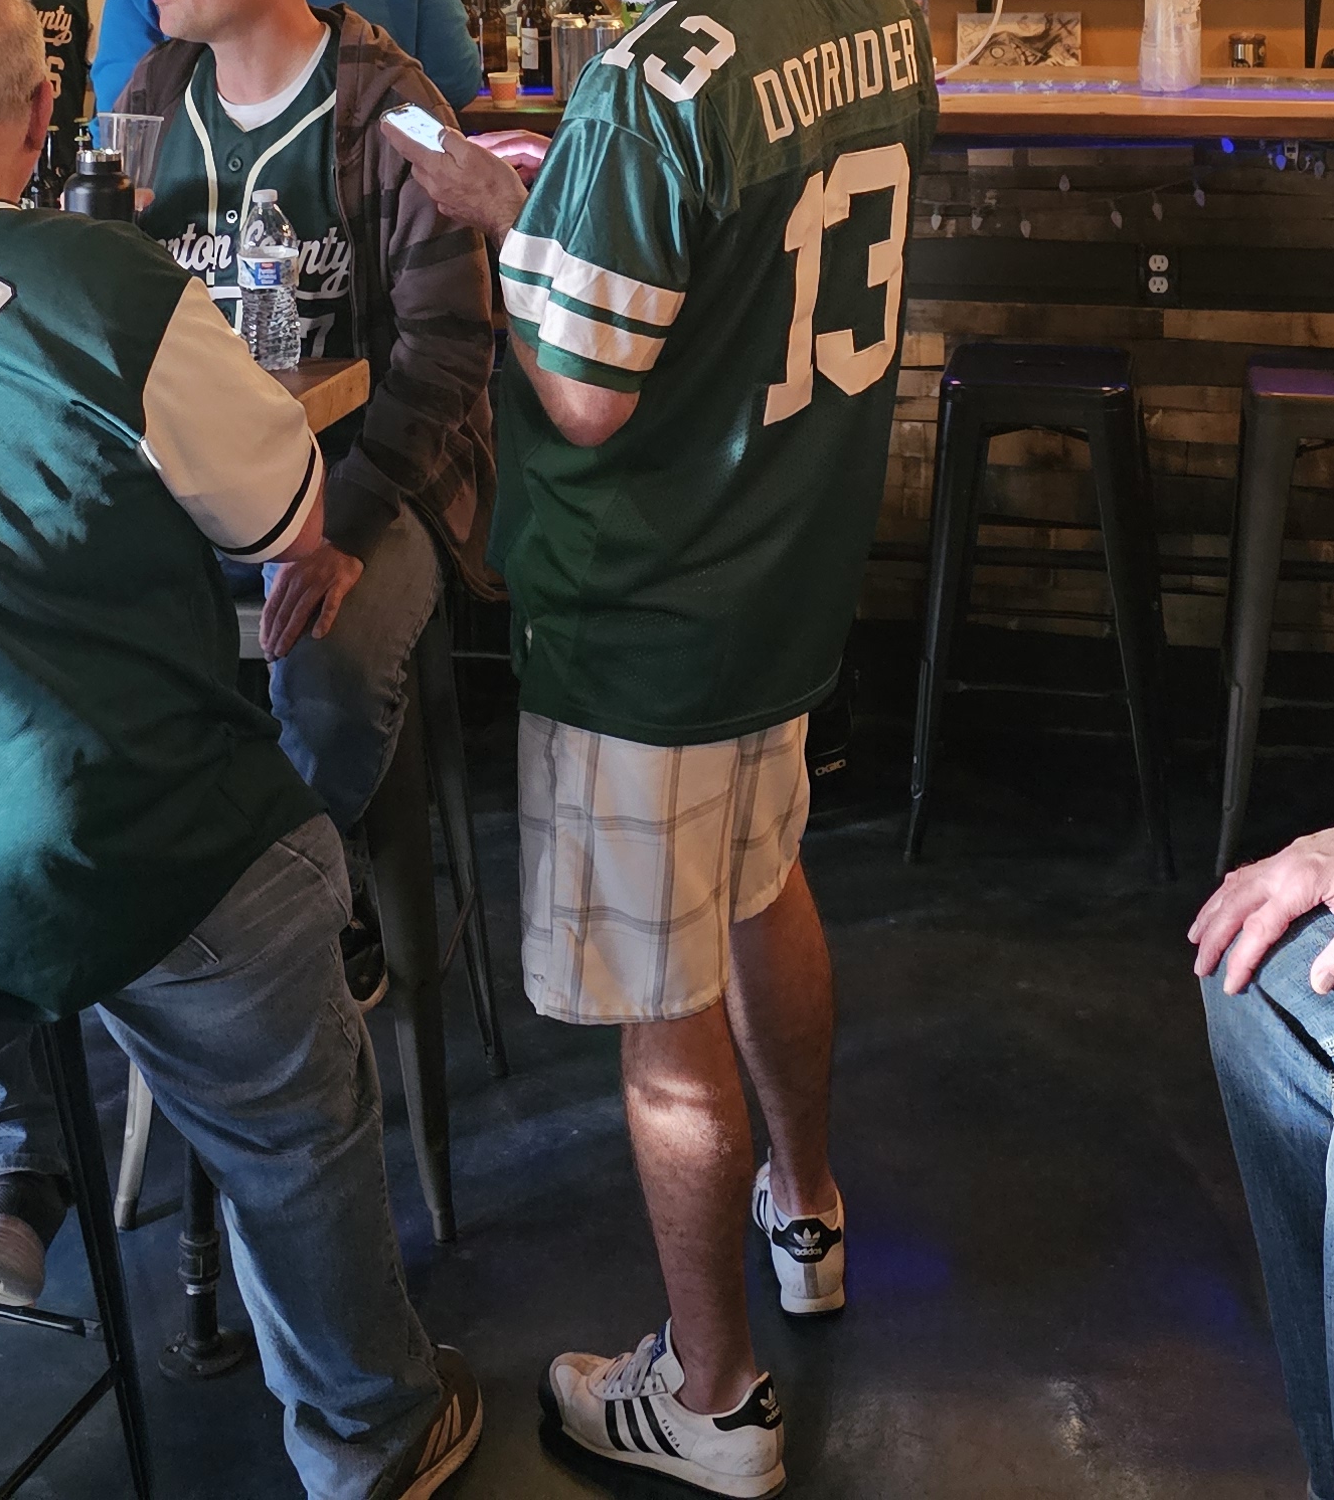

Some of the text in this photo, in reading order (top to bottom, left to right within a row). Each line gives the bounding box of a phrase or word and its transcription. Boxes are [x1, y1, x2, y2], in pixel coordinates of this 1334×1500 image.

[601, 0, 736, 103] 13
[753, 19, 918, 144] DOTRIDER
[159, 222, 233, 270] nton
[763, 142, 911, 427] 13
[794, 1247, 823, 1256] adidas
